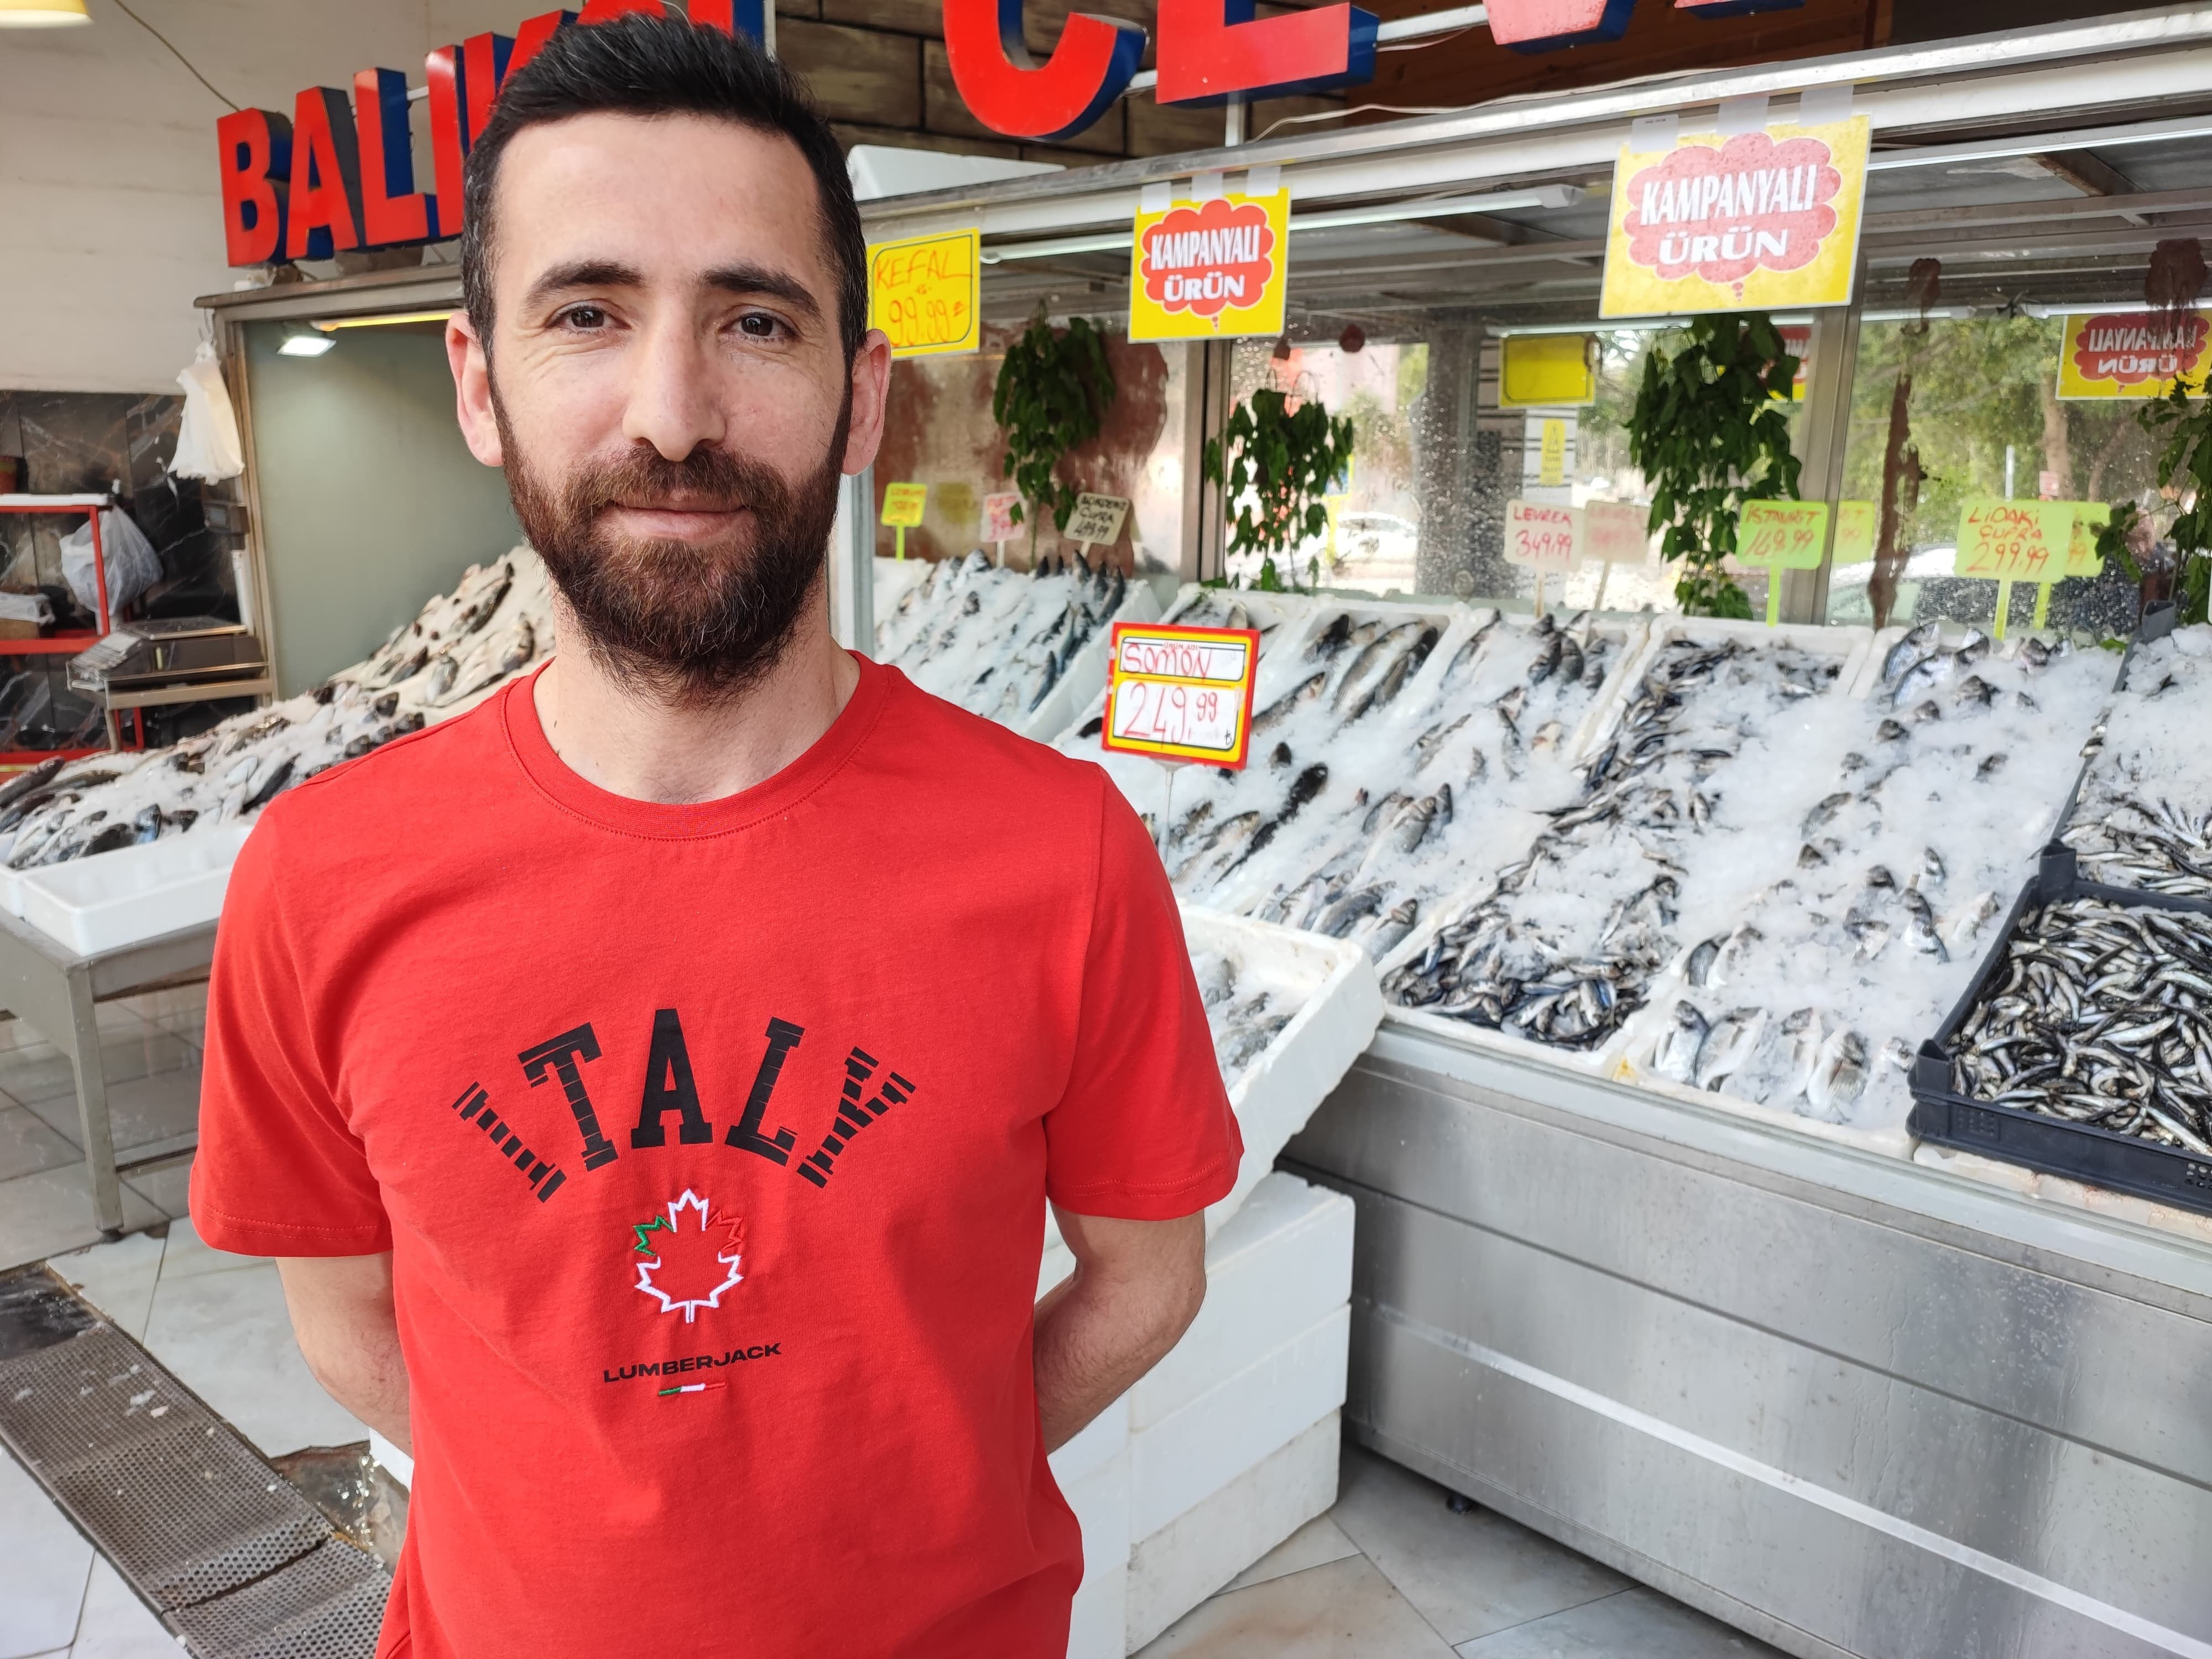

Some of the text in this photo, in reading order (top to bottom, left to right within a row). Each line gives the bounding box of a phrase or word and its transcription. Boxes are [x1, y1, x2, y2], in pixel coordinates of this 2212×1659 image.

[1640, 164, 1818, 226] KAMPANYALI
[1151, 224, 1260, 270] KAMPANYALI
[1658, 226, 1789, 265] ÜRÜN
[876, 249, 972, 290] KEFAL
[1164, 271, 1245, 302] ÜRÜN
[452, 1008, 916, 1203] ITALY
[603, 1343, 782, 1383] LUMBERJACK
